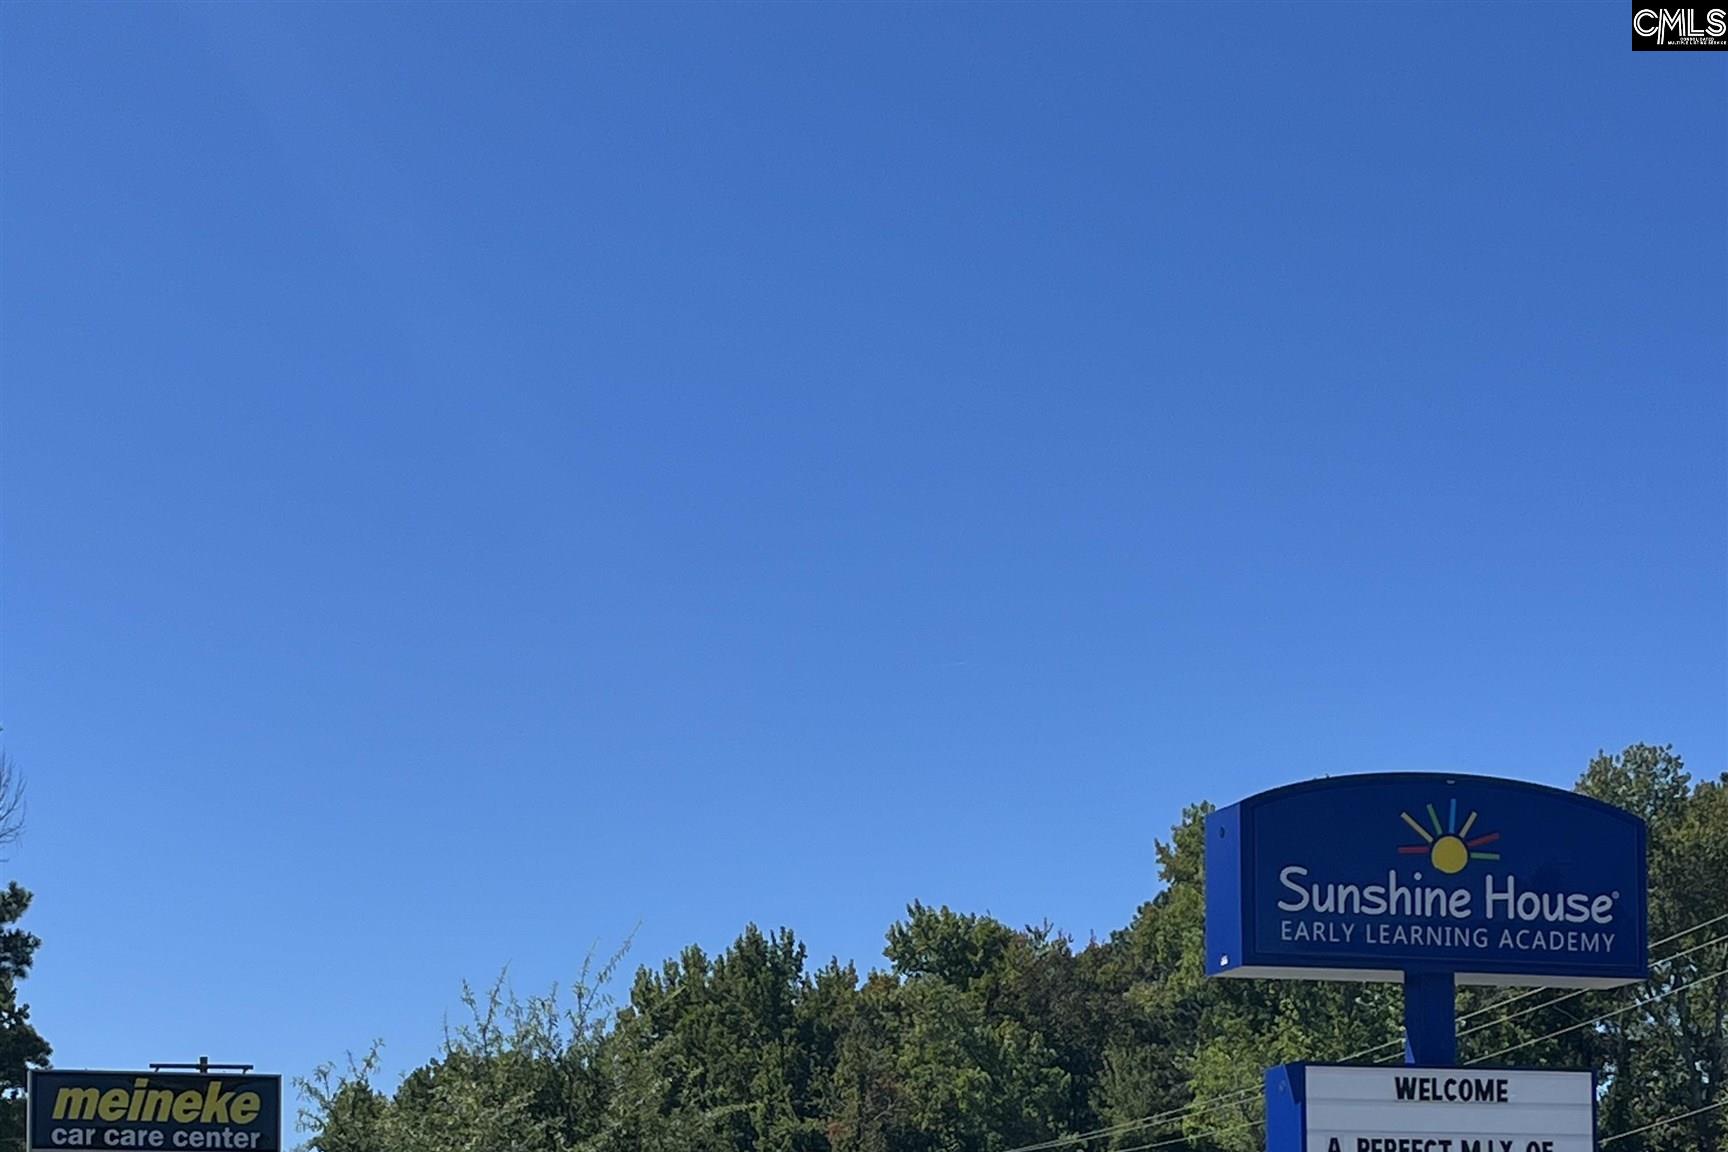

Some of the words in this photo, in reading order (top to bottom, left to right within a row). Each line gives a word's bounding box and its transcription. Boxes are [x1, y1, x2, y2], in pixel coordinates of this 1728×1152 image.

[1278, 865, 1472, 918] Sunshine
[1485, 874, 1615, 924] House
[1280, 920, 1355, 942] EARLY
[1366, 923, 1489, 948] LEARNING
[1499, 929, 1616, 953] ACADEMY
[52, 1078, 261, 1125] meineke
[1395, 1076, 1508, 1103] WELCOME
[51, 1127, 96, 1145] car
[103, 1127, 164, 1148] care
[172, 1127, 262, 1149] center
